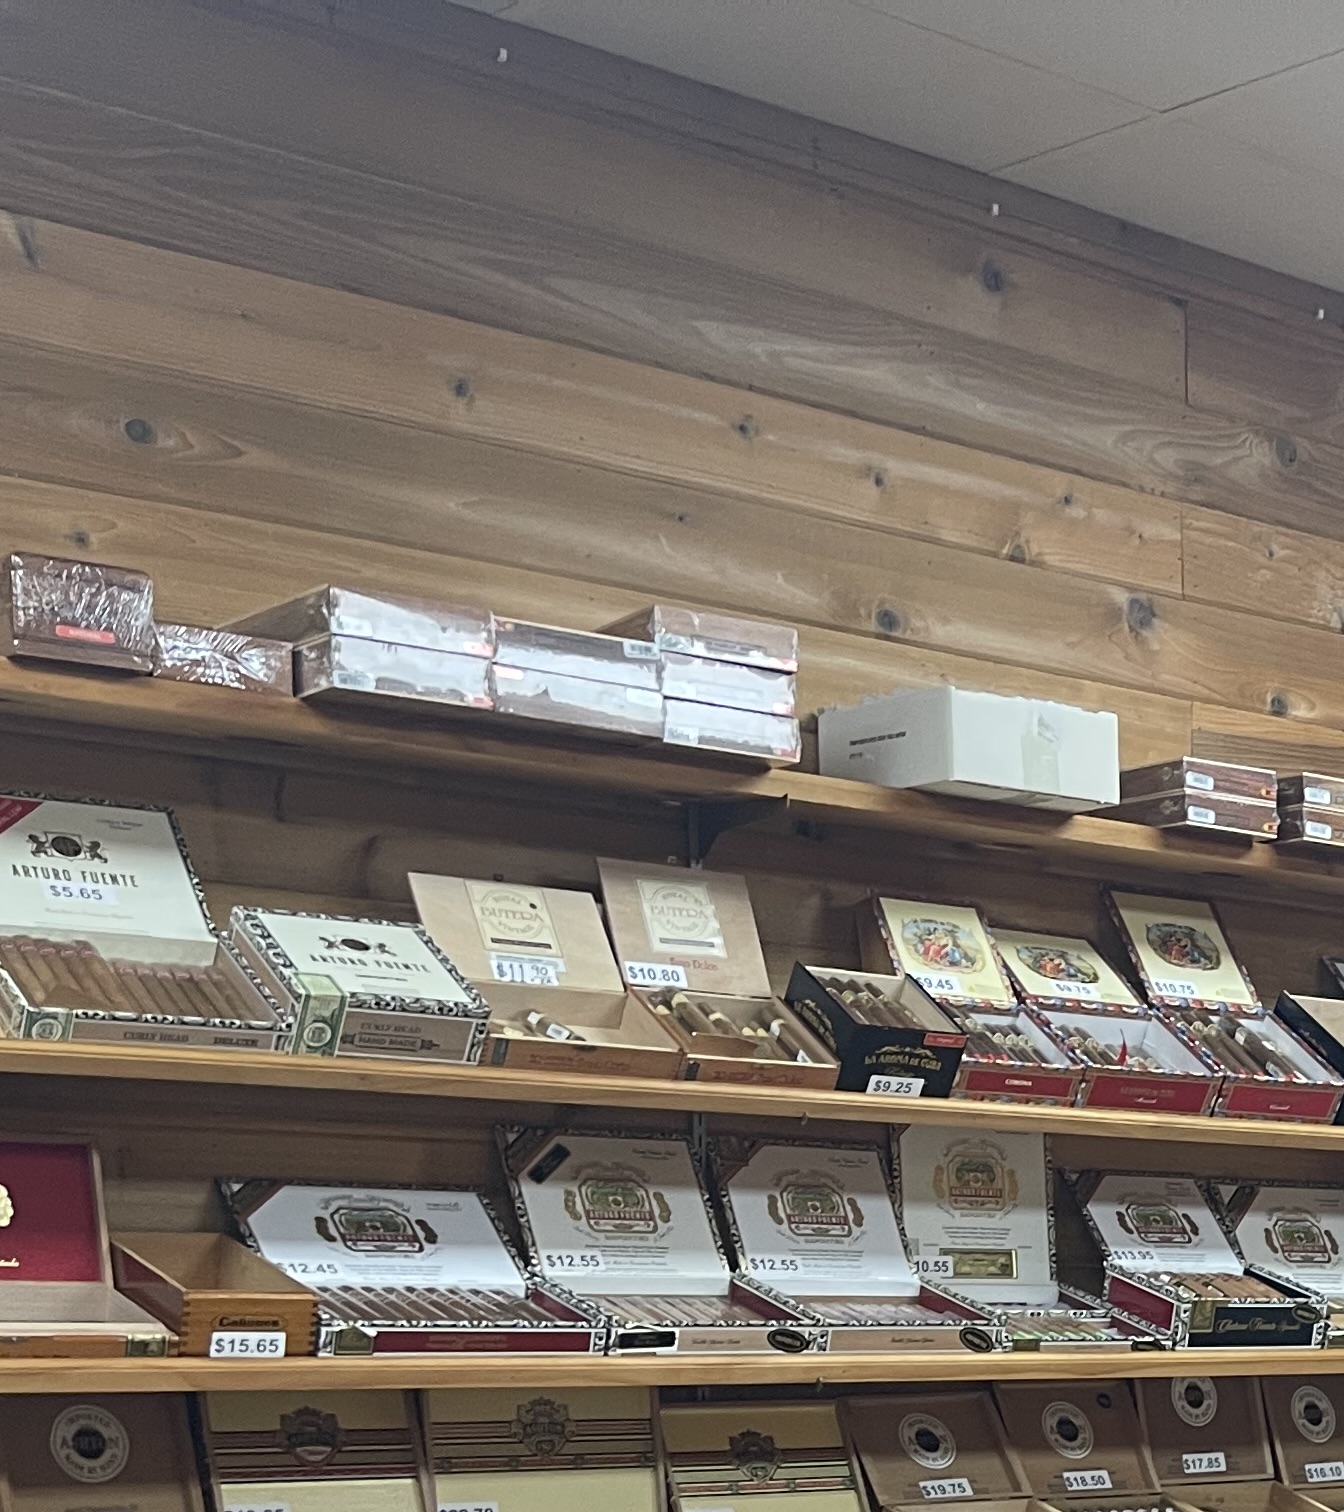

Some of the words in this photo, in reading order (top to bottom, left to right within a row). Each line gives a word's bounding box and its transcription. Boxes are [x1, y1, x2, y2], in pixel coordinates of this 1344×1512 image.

[12, 863, 72, 882] ARTURO
[81, 869, 139, 888] FUENTE
[49, 885, 103, 901] $5.65
[628, 966, 680, 983] $10.80
[1155, 981, 1195, 995] $10.75
[873, 1080, 913, 1094] $9.25
[545, 1254, 600, 1268] $12.55
[749, 1257, 799, 1271] $12.55
[215, 1338, 279, 1355] $15.65
[1307, 1465, 1342, 1479] $16.10
[1065, 1474, 1106, 1488] $18.50
[922, 1483, 966, 1497] $19.75
